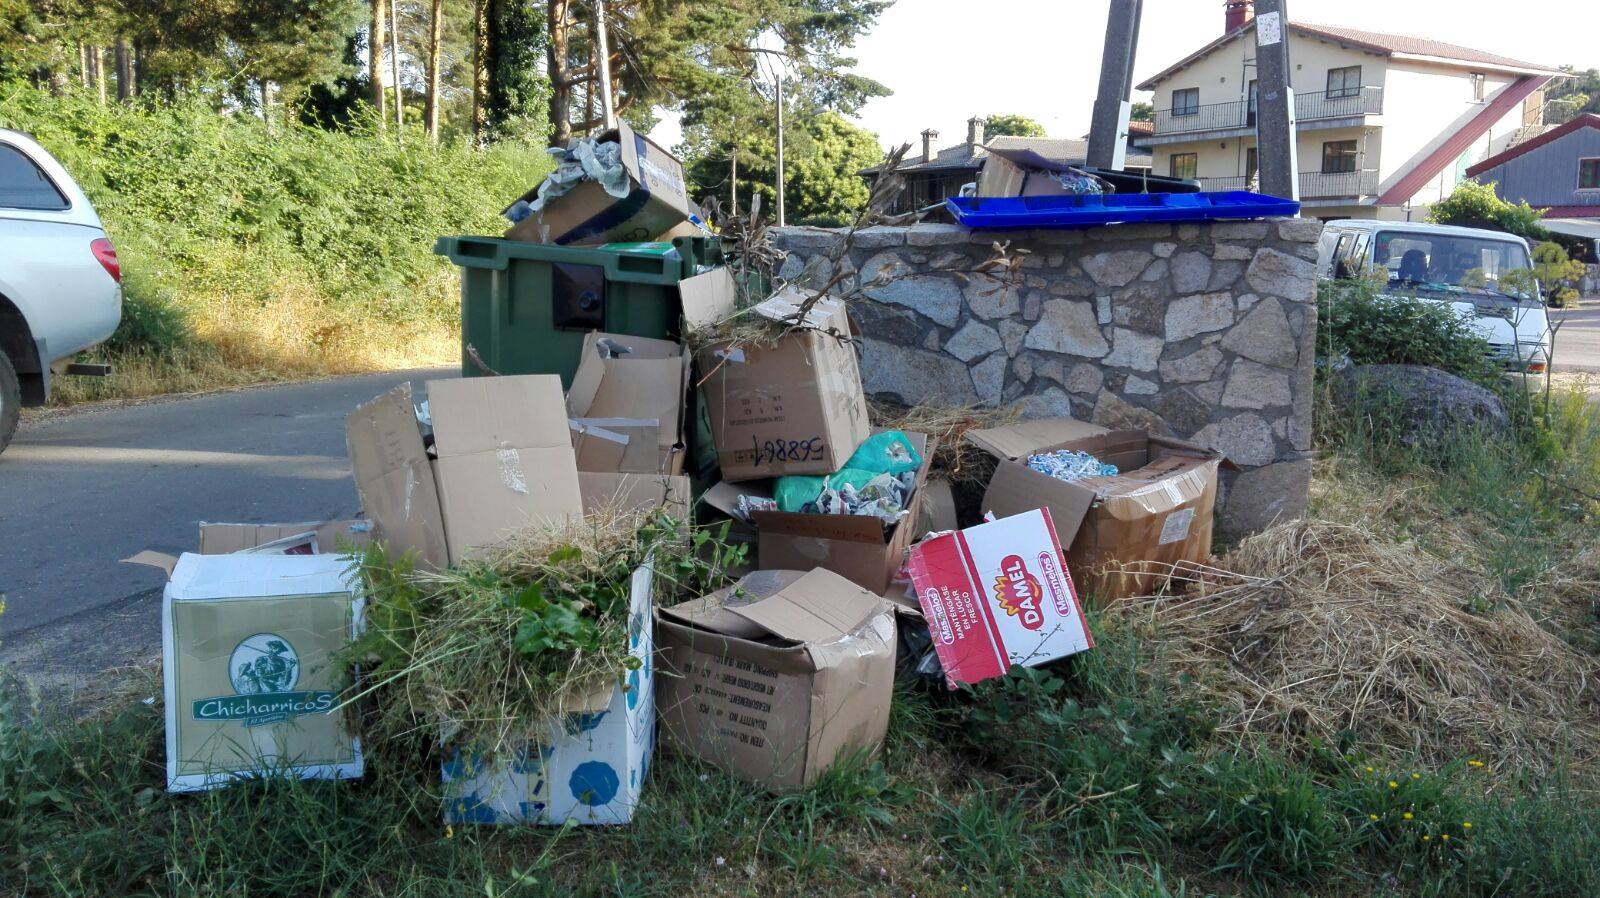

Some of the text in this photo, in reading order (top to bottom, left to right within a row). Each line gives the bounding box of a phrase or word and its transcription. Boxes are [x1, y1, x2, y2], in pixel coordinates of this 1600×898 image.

[1007, 560, 1041, 625] DAMEL
[1043, 557, 1069, 611] Masmelos
[952, 589, 971, 631] EN LUGAR
[962, 591, 979, 624] FRESCO
[739, 715, 768, 731] QUANTITY
[749, 734, 765, 748] ITEM
